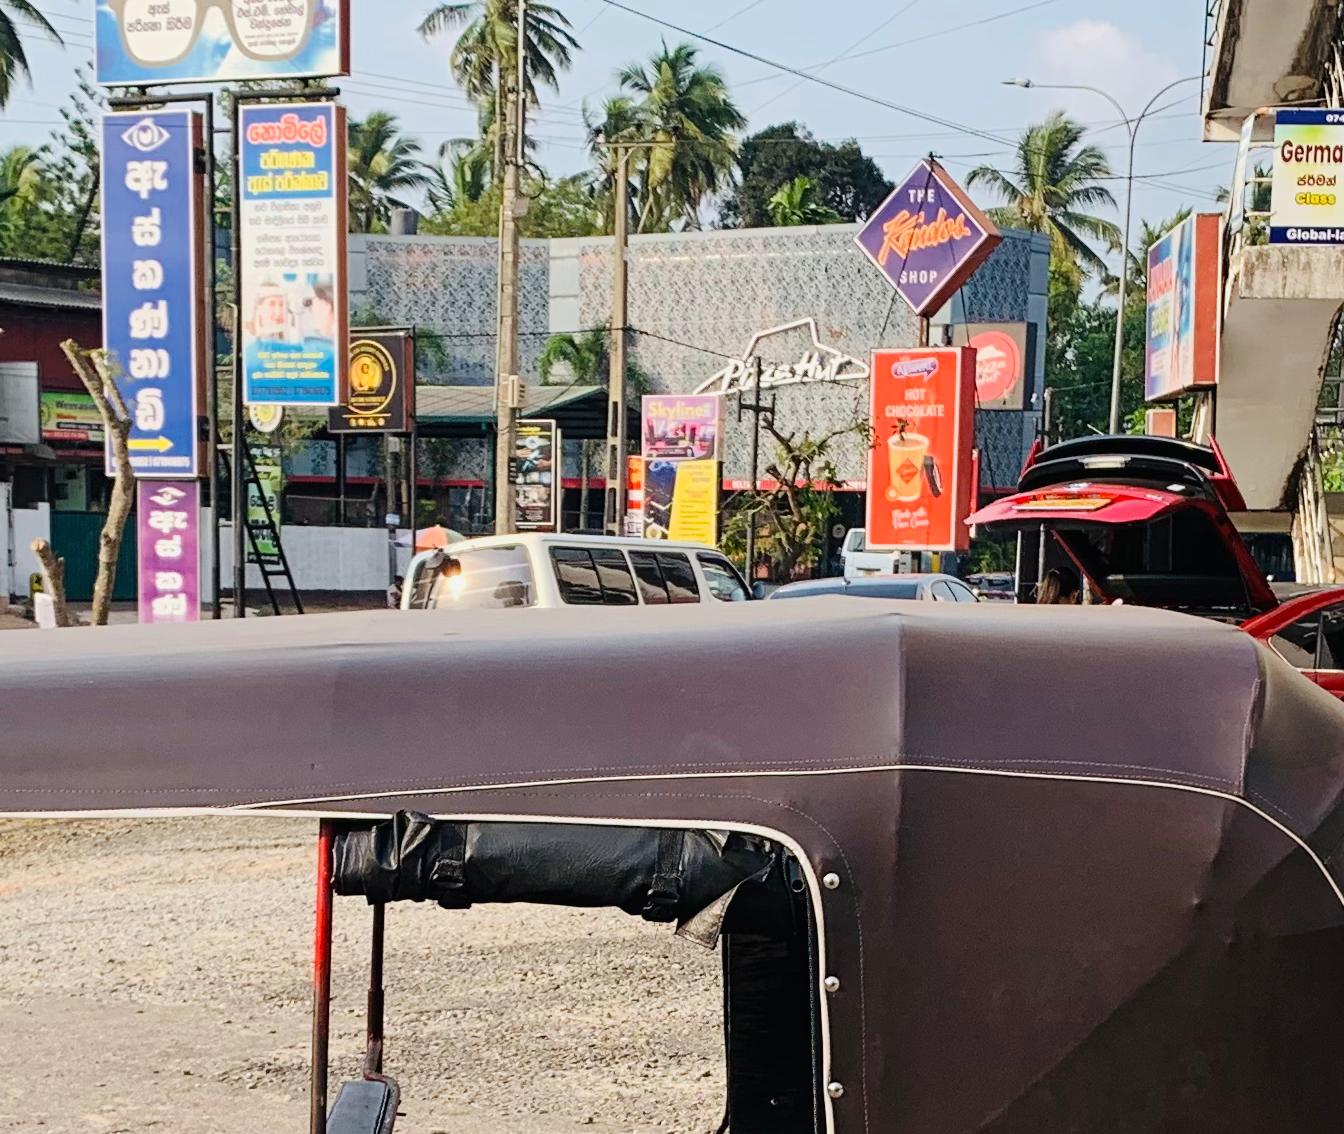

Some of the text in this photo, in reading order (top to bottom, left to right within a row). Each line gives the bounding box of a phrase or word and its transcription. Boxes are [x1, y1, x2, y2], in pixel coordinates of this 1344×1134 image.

[908, 188, 935, 203] THE
[1295, 193, 1337, 205] Class
[899, 270, 938, 284] SHOP
[794, 350, 844, 383] Hut
[904, 388, 927, 401] HOT
[885, 404, 945, 417] CHOCOLATE
